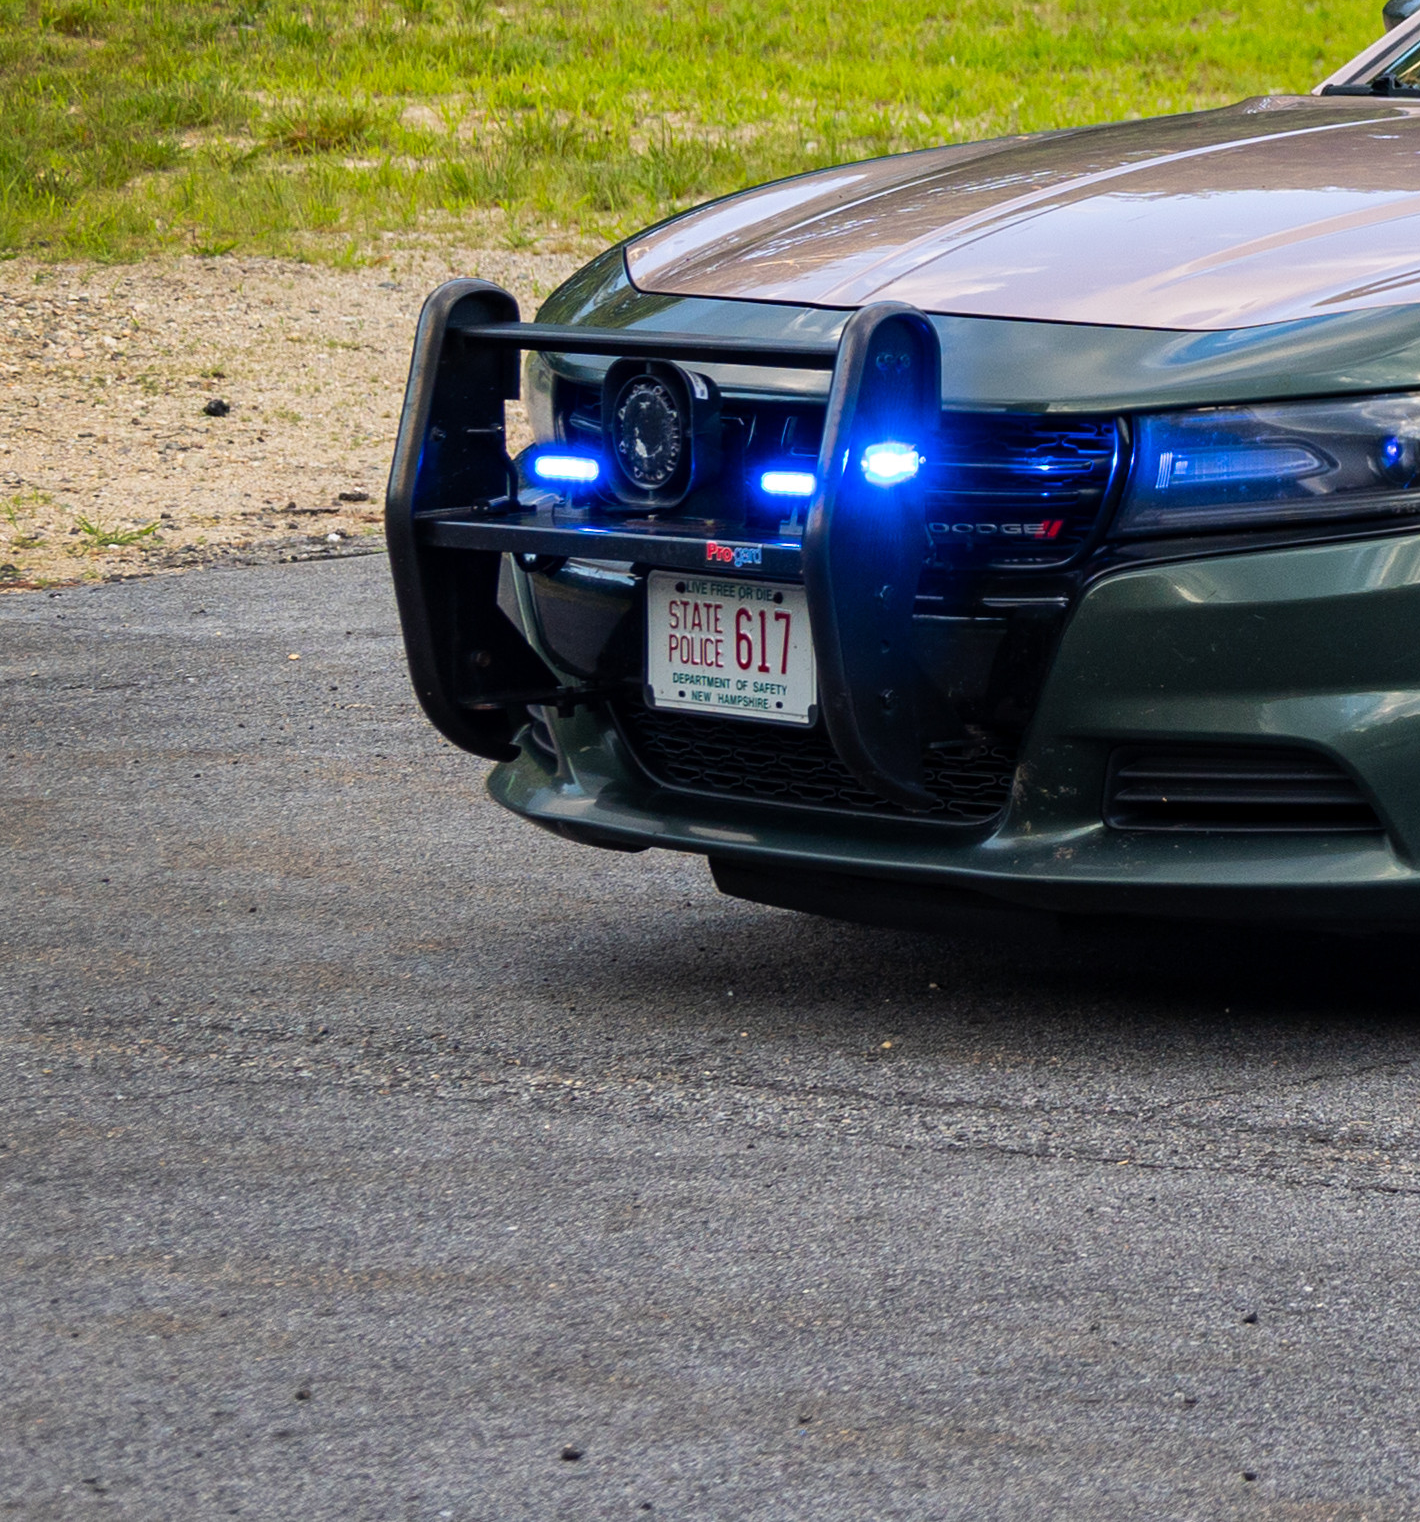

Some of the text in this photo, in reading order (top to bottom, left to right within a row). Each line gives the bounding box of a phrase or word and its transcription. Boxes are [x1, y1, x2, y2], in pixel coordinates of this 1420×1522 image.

[928, 522, 1046, 535] DODGE
[686, 582, 773, 602] LIVE FREE OR DIE
[669, 599, 724, 634] STATE
[668, 633, 725, 668] POLICE
[734, 607, 792, 675] 617
[672, 672, 788, 696] DEPARTMENT OF SAFETY
[691, 690, 769, 710] NEW HAMPSHIRE
